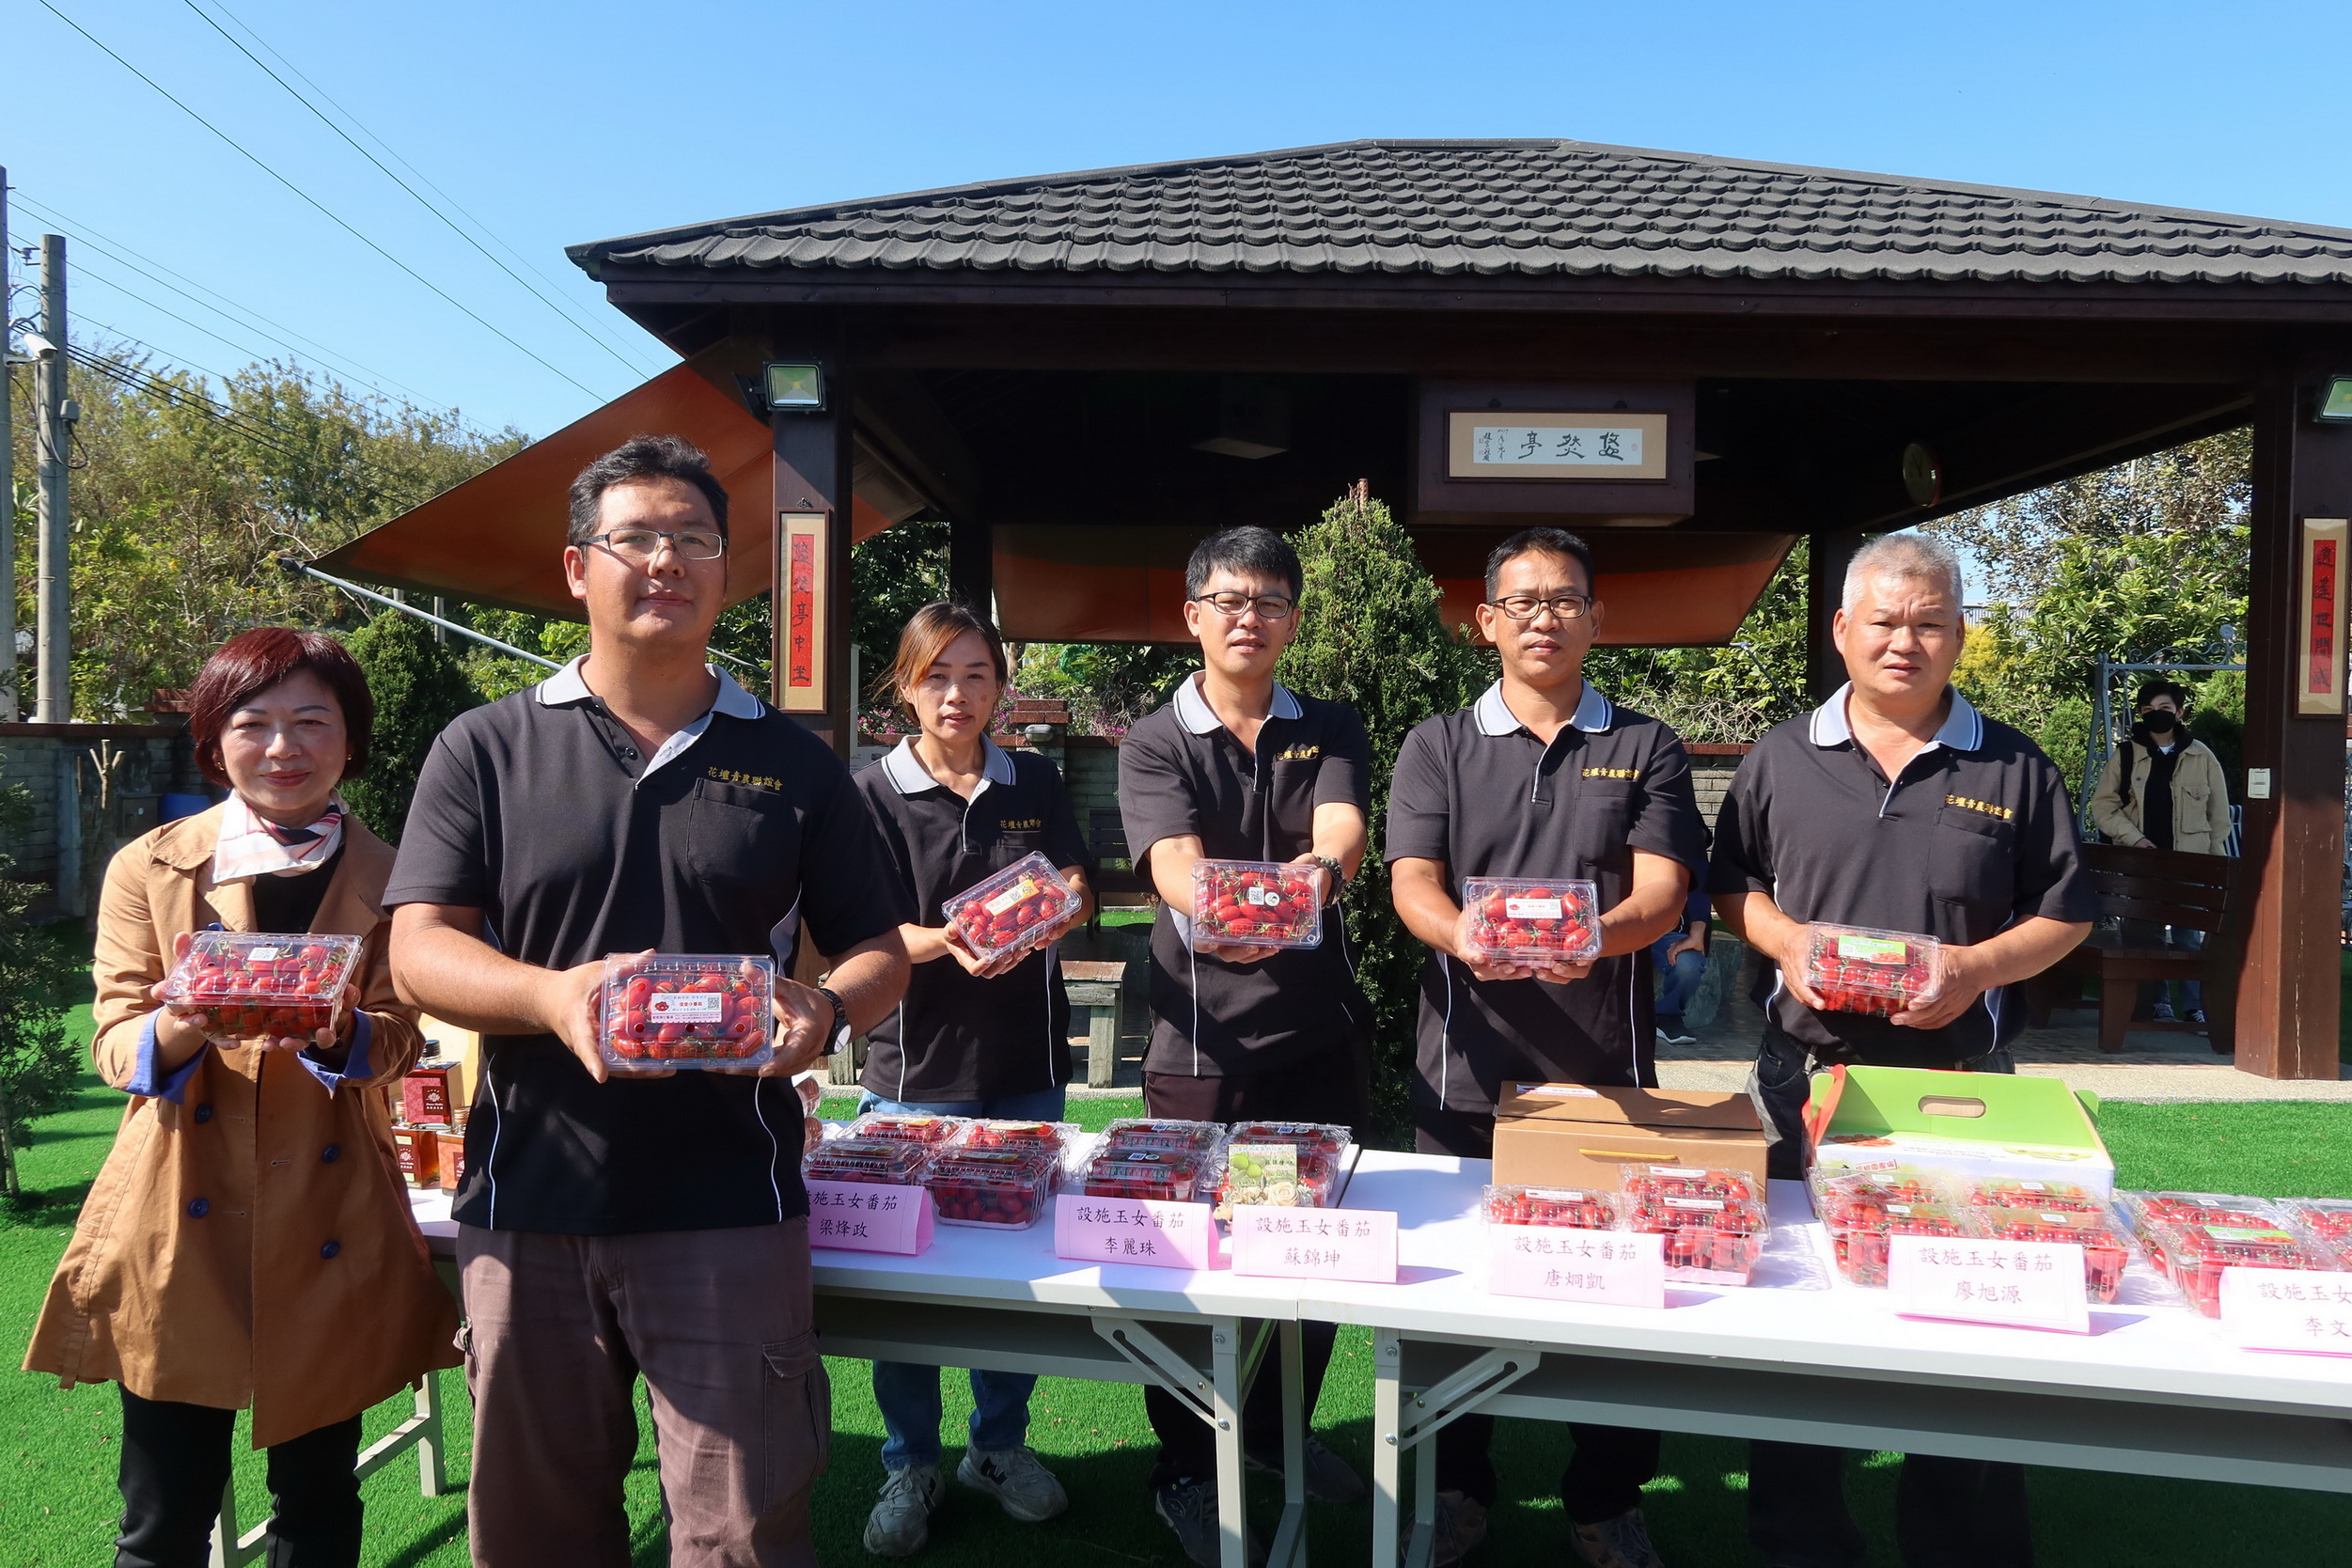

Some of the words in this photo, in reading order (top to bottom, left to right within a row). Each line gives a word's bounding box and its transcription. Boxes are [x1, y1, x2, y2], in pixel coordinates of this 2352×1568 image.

[819, 1218, 870, 1239] 梁烽政
[1076, 1206, 1184, 1229] 設施玉女番茄
[1255, 1216, 1372, 1238] 設施玉女番茄
[1105, 1236, 1157, 1257] 李麗珠
[1283, 1247, 1341, 1269] 蘇錦坤
[1513, 1235, 1637, 1261] 設施玉女番茄
[1918, 1247, 2054, 1272] 設施玉女番茄
[1953, 1279, 2024, 1305] 廖旭源
[2256, 1282, 2352, 1305] 設施玉女
[2304, 1315, 2352, 1338] 李文
